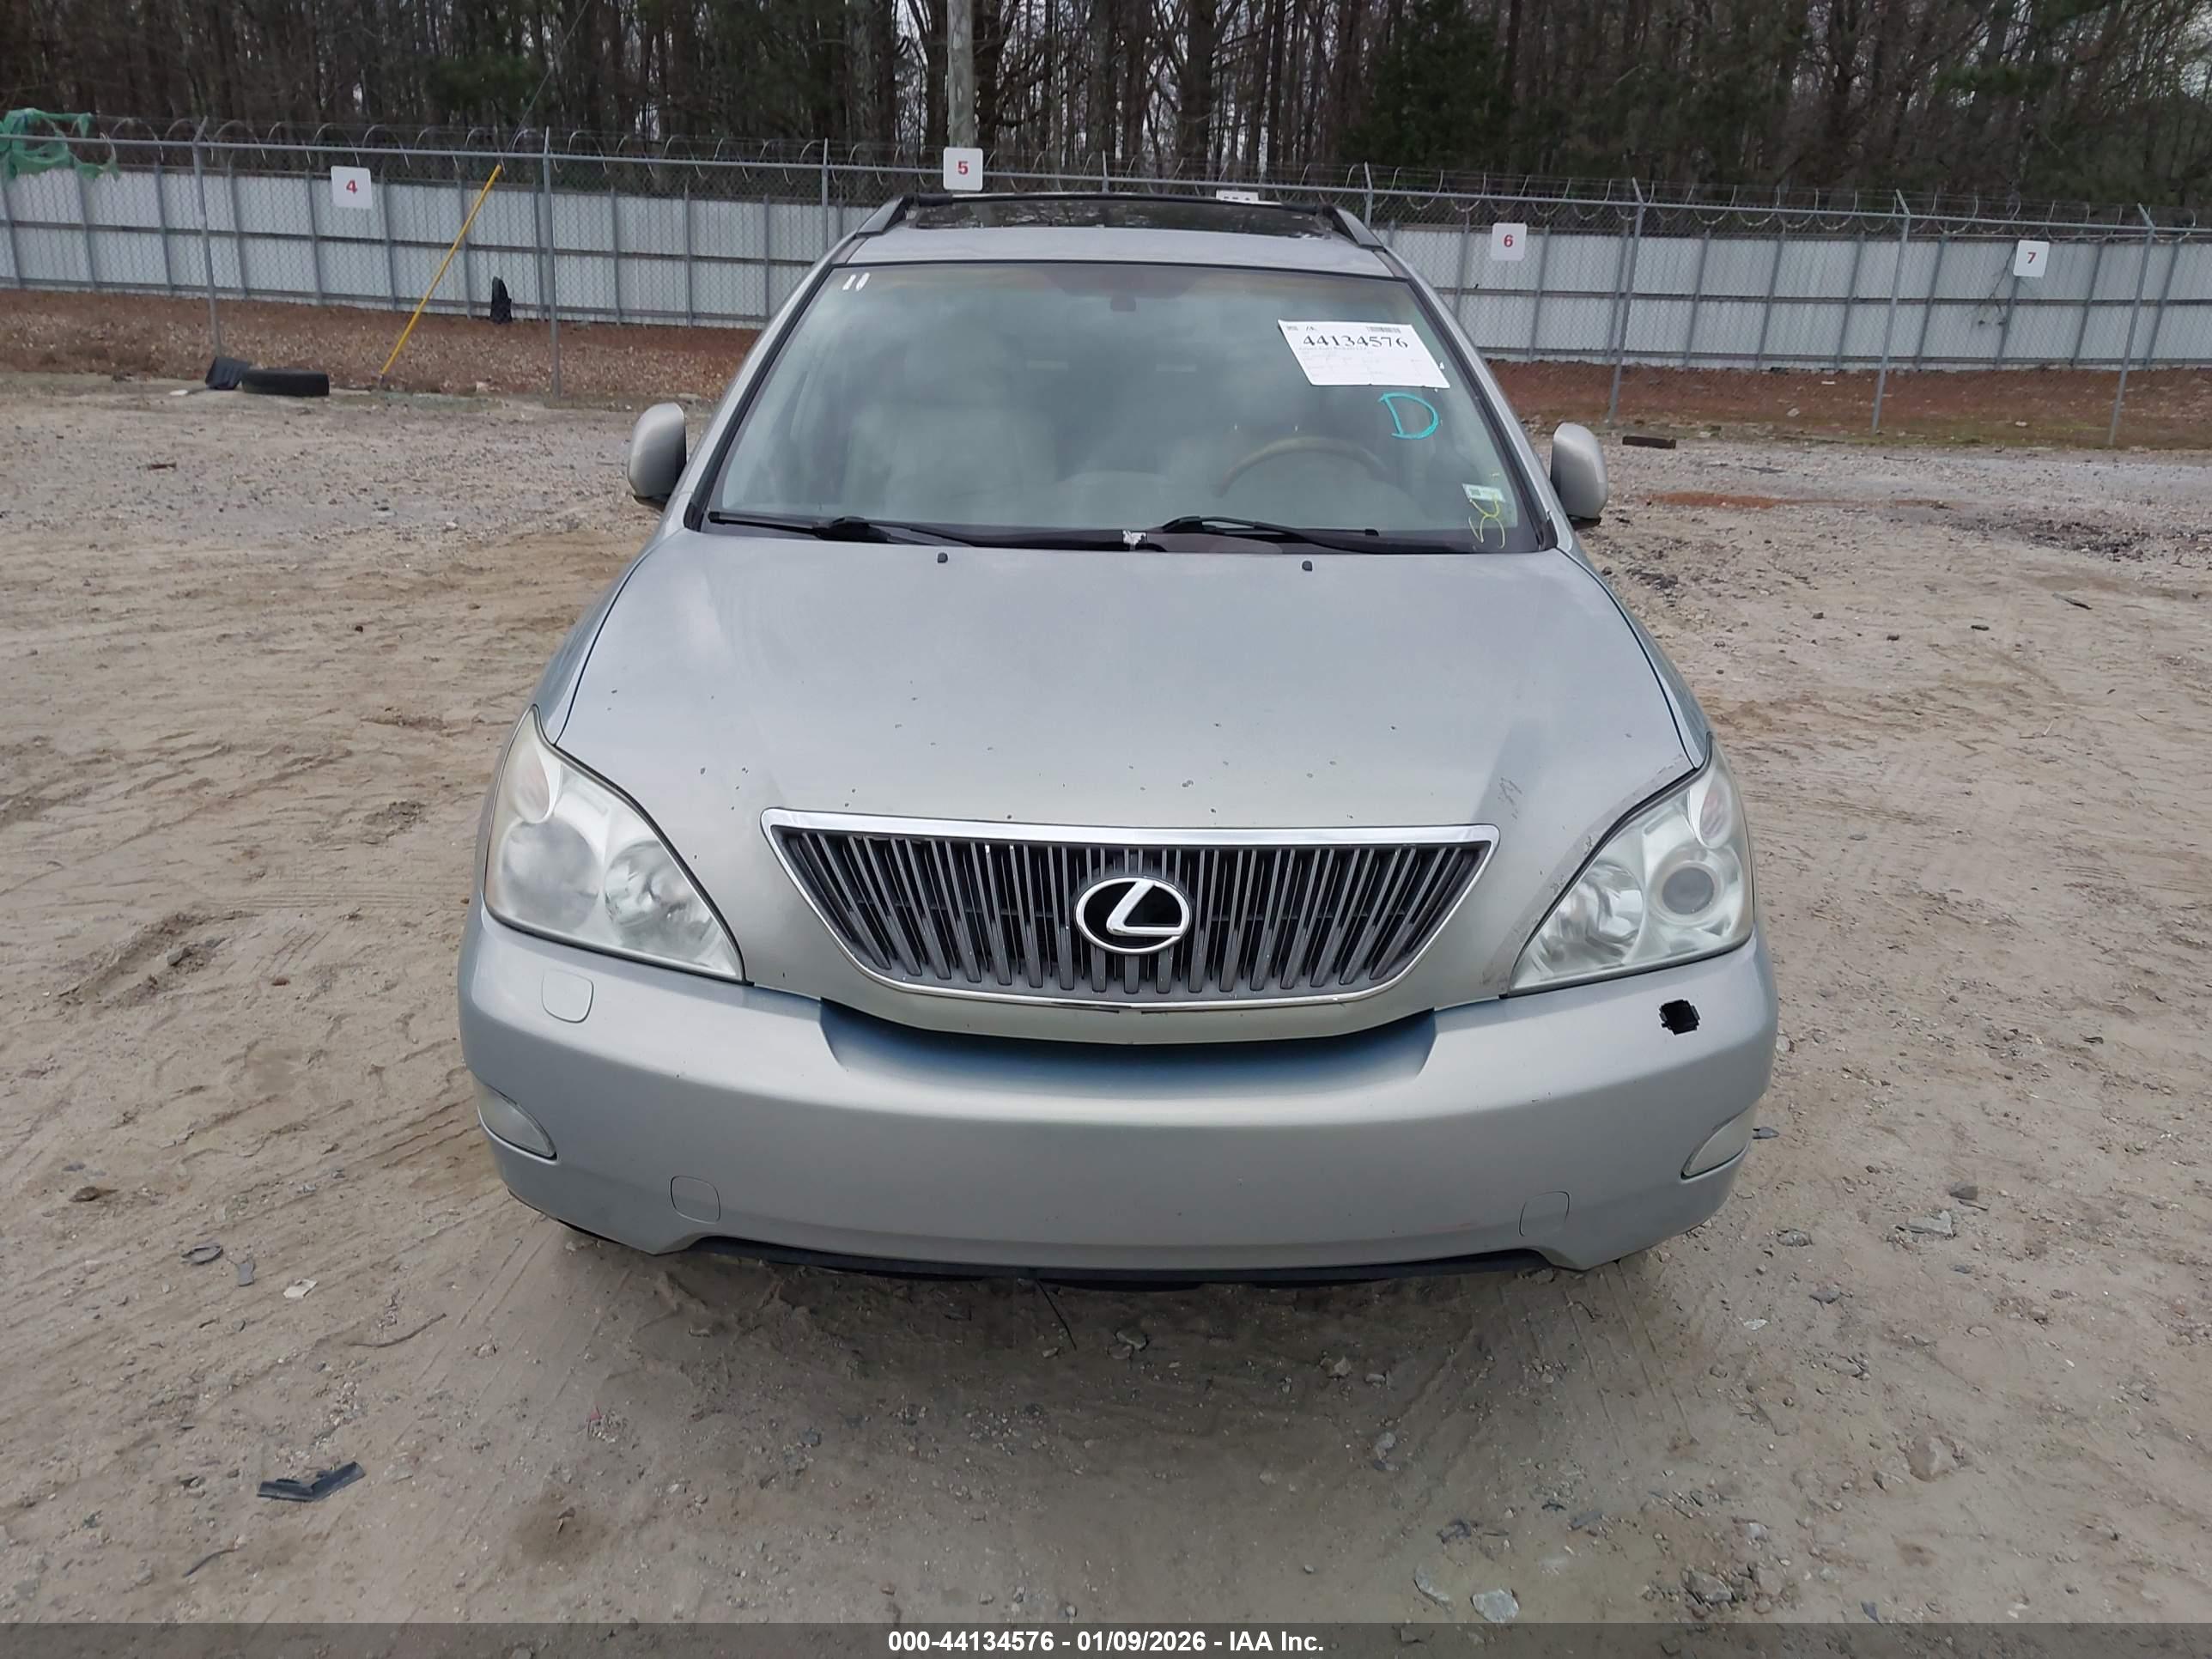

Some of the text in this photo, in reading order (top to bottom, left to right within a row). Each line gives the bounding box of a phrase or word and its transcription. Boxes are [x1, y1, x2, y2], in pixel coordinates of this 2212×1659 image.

[957, 160, 969, 175] 5
[345, 179, 358, 194] 4
[1504, 234, 1514, 247] 6
[2027, 251, 2037, 264] 7
[1303, 334, 1408, 349] 44134576
[1377, 392, 1438, 440] D
